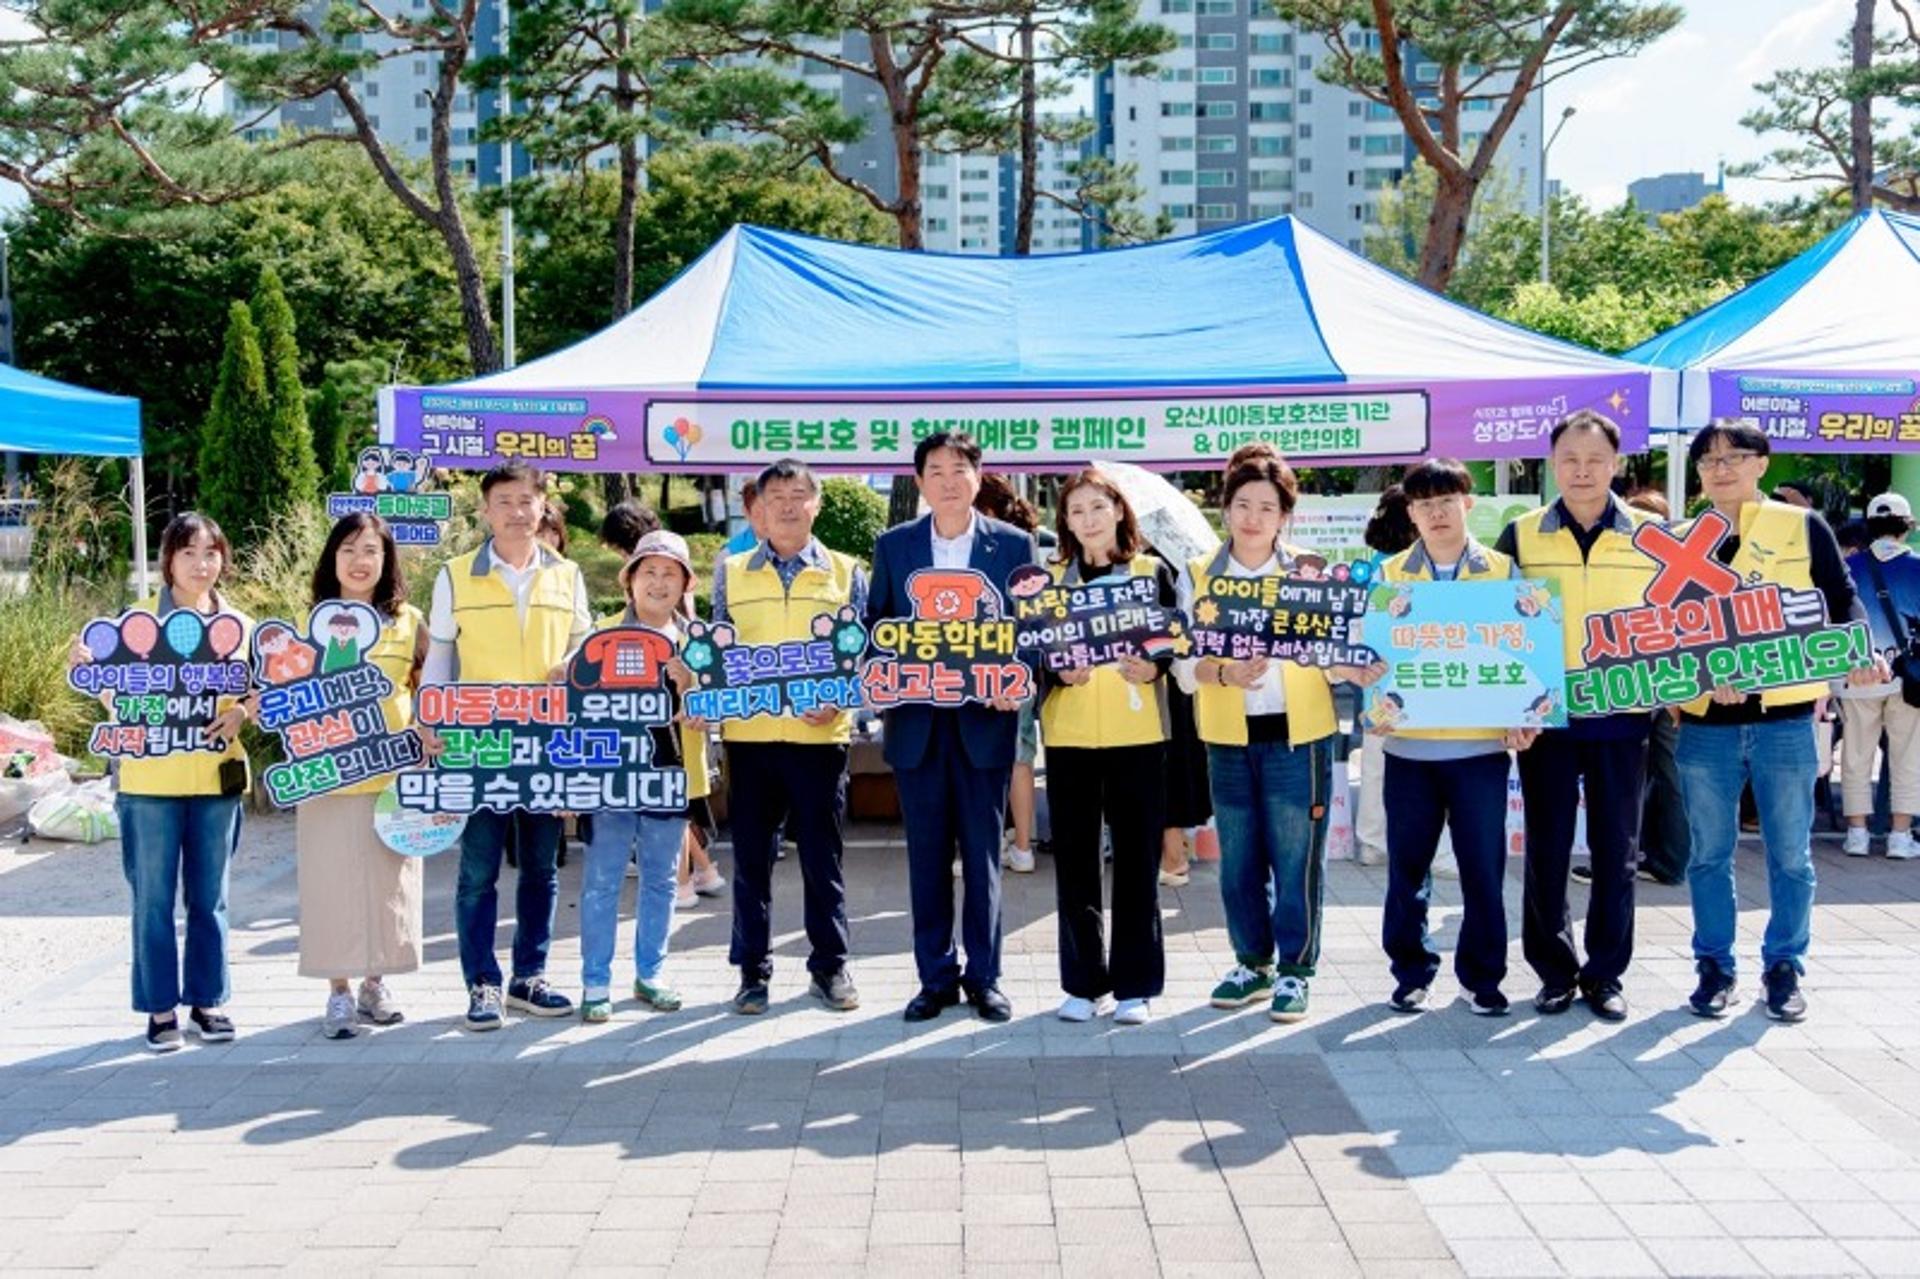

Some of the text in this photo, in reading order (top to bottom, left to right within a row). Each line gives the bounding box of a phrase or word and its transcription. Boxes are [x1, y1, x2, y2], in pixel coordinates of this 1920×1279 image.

[1164, 402, 1390, 427] 오산시아동보호전문기관
[1765, 416, 1813, 440] 시절,
[1819, 412, 1895, 441] 우리의
[421, 431, 597, 460] 그 시절, 우리의 꿈
[731, 419, 857, 452] 아동보호
[870, 419, 898, 452] 및
[1051, 416, 1146, 451] 캠페인
[1193, 433, 1212, 453] &
[1018, 579, 1156, 619] 사랑으로 자란
[1212, 577, 1368, 613] 아이들에게 남길
[875, 619, 1015, 660] 아동학대
[1017, 606, 1165, 647] 아이의 미래는
[1228, 608, 1348, 640] 가장 큰 유산은
[1391, 621, 1535, 653] 따뜻한 가정,
[1584, 584, 1824, 662] 사랑의 매는
[723, 641, 836, 687] 꽃으로도
[1050, 641, 1142, 669] 다릅니다.
[1192, 629, 1375, 667] 폭력 없는 세상입니다
[74, 663, 249, 695] 아이들의 행복은
[865, 661, 1028, 703] 신고는 112
[1394, 660, 1528, 689] 든든한 보호
[1564, 625, 1870, 715] 더이상 안돼요!
[115, 694, 215, 725] 가정에서
[260, 665, 391, 727] 유괴예방,
[418, 686, 666, 726] 아동학대, 우리의
[686, 682, 781, 720] 때리지
[285, 705, 385, 757] 관심이
[436, 727, 650, 769] 관심과 신고가
[270, 731, 423, 802] 안전입니다
[400, 771, 686, 810] 막을 수 있습니다!
